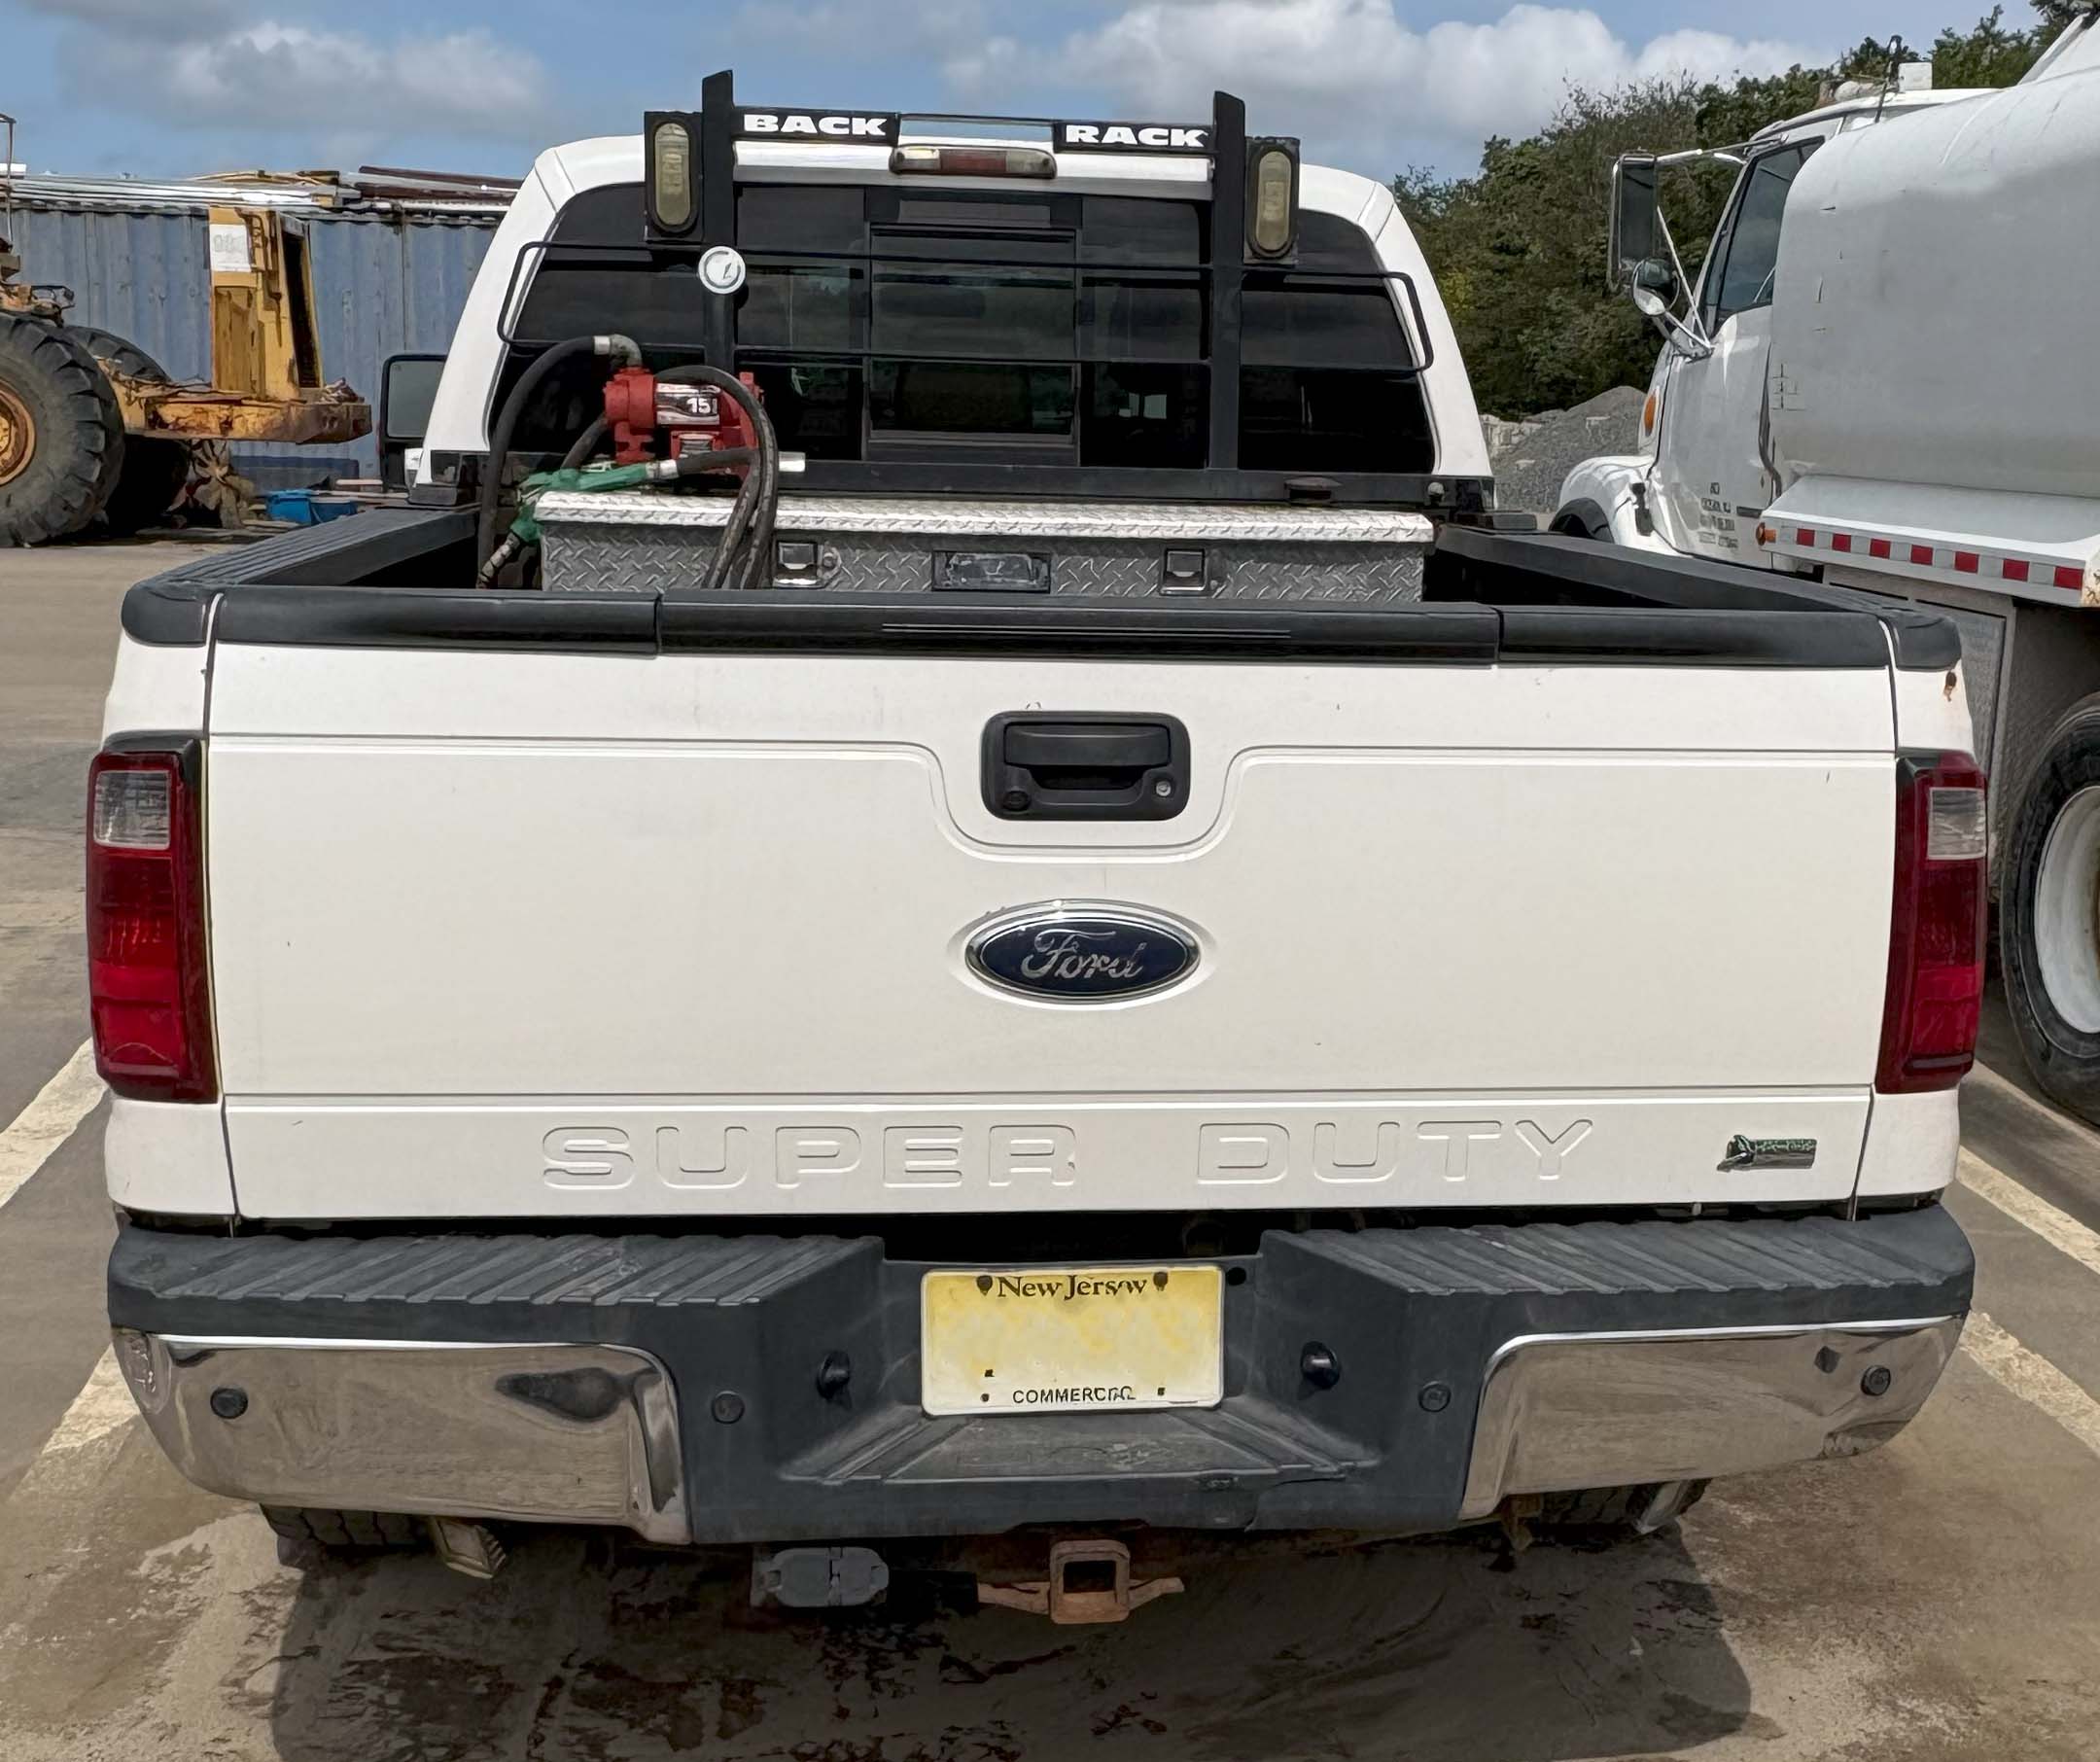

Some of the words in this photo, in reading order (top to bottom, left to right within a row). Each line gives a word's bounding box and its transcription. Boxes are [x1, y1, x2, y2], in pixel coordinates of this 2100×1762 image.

[744, 114, 887, 136] BACK
[1066, 124, 1208, 147] RACK
[1021, 928, 1146, 979] Ford
[542, 1125, 1075, 1189] SUPER
[1197, 1119, 1593, 1184] DUTY
[997, 1276, 1063, 1298] New
